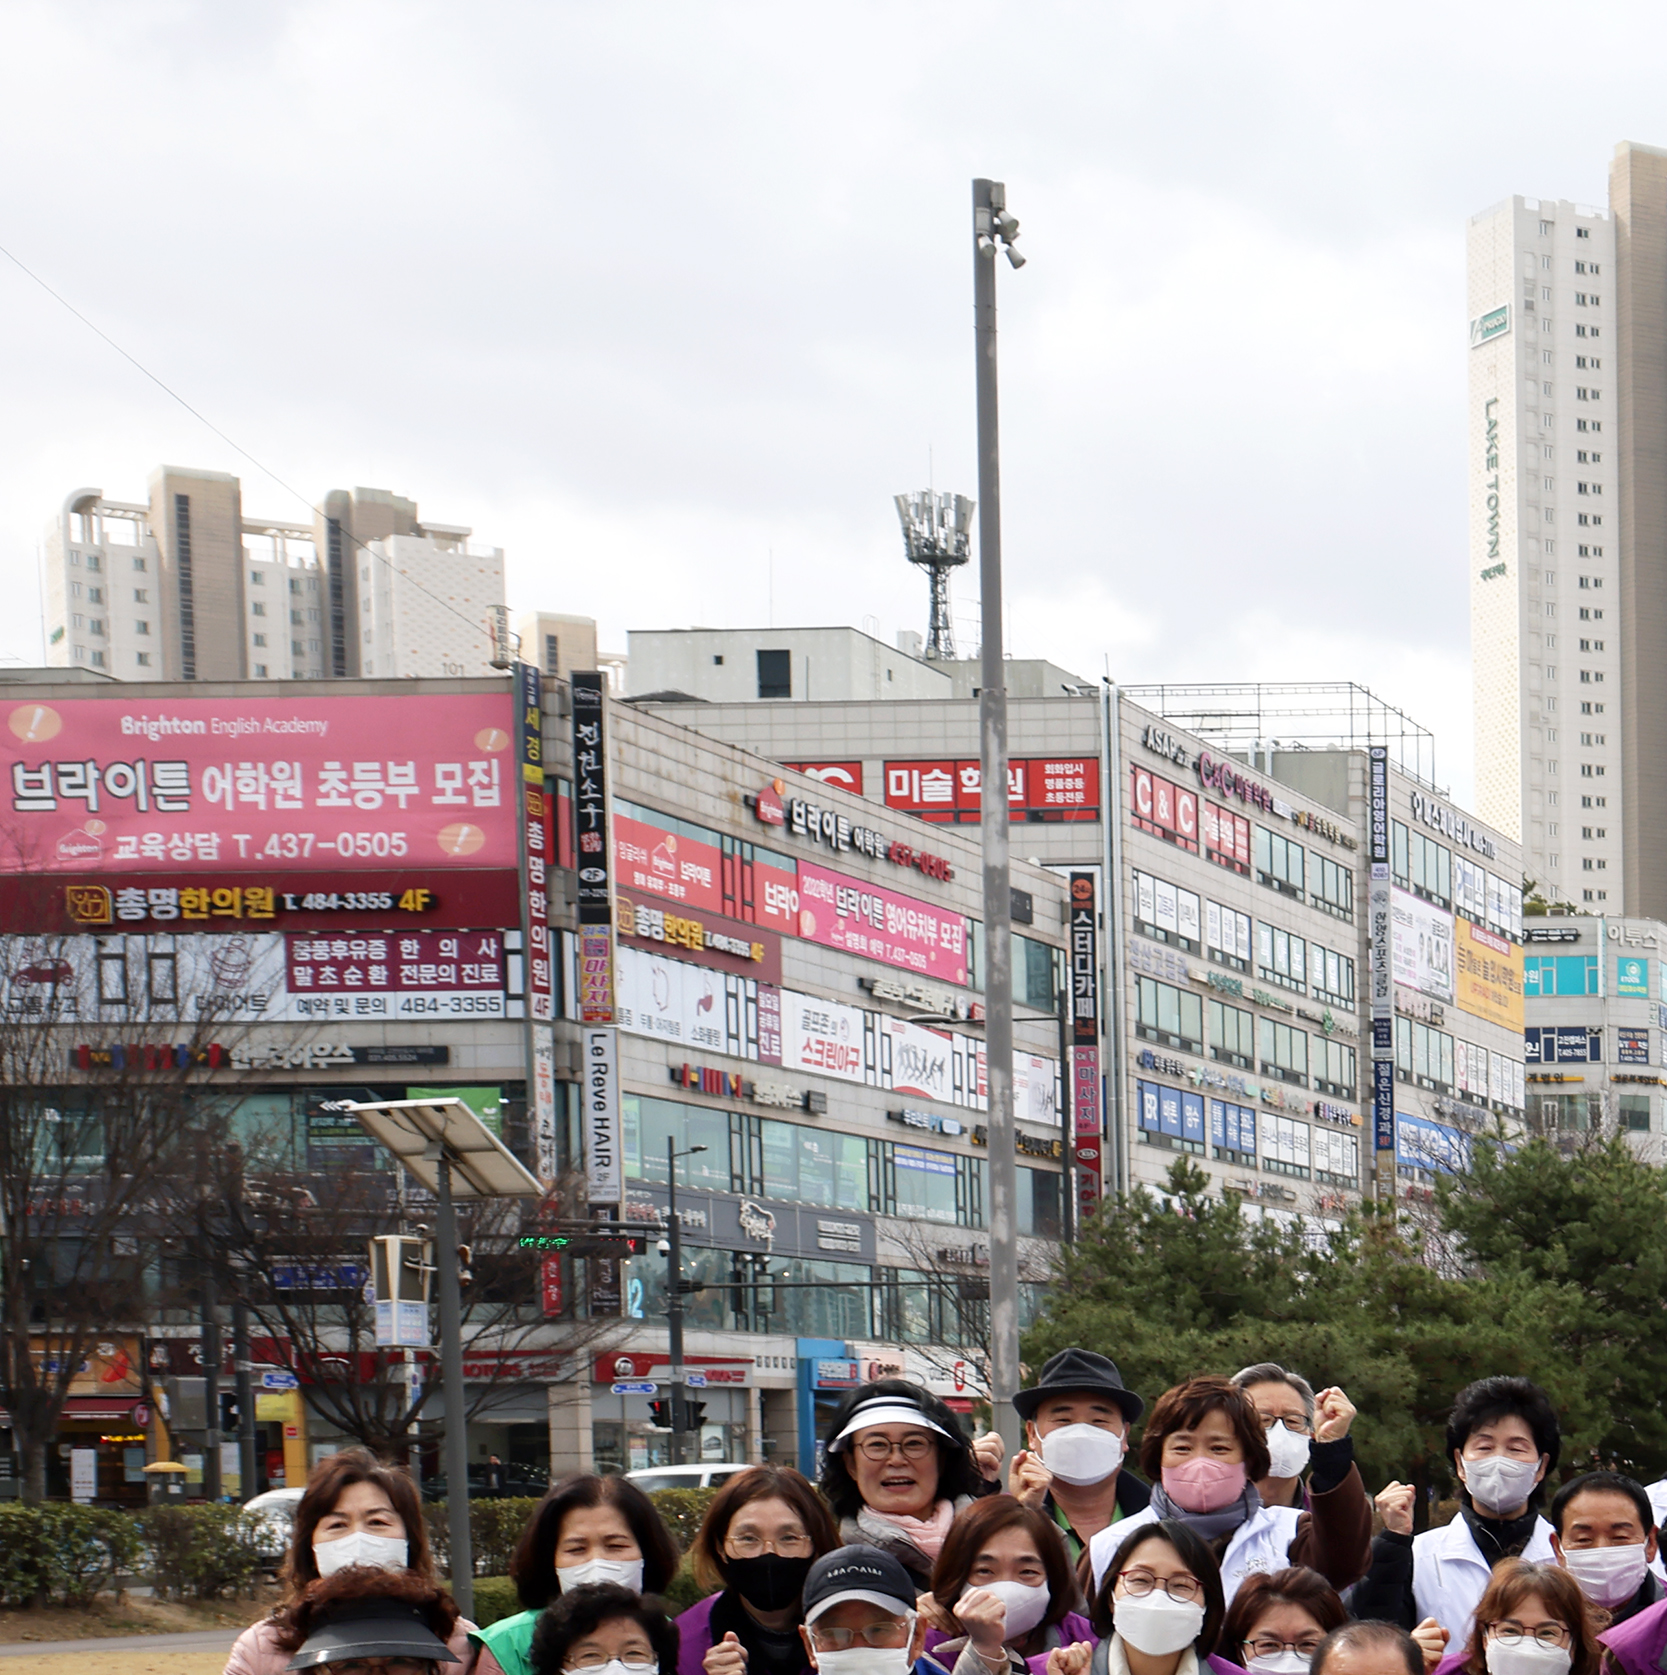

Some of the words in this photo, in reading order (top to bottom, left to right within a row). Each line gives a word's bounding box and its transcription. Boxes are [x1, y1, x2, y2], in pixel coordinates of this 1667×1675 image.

[1485, 396, 1499, 472] LAKE
[1486, 474, 1500, 558] TOWN
[121, 715, 206, 742] Brighton
[211, 717, 261, 738] English
[263, 717, 328, 737] Academy
[12, 758, 191, 813] 브라이튼
[202, 761, 304, 811] 어학원
[316, 760, 420, 810] 초등부
[431, 758, 502, 807] 모집
[113, 832, 221, 861] 교육상담
[791, 797, 850, 852] 브라이튼
[853, 826, 885, 859] 어학원
[888, 840, 951, 882] 437-0505
[680, 861, 712, 888] 브라이튼
[115, 886, 277, 920] 총명한의원
[301, 892, 392, 911] 484-3355
[398, 888, 431, 912] 4F
[527, 821, 549, 988] 총명한의원
[835, 884, 884, 931] 브라이튼
[940, 921, 963, 955] 모집
[634, 904, 704, 952] 총명한의원
[1607, 925, 1658, 949] 이투스
[400, 964, 457, 985] 전문의
[461, 963, 501, 984] 진료
[584, 959, 609, 1004] 마사지
[1073, 910, 1097, 1019] 스터디카페
[297, 996, 331, 1015] 예약
[335, 997, 350, 1014] 및
[354, 996, 387, 1015] 문의
[401, 996, 502, 1014] 484-3355
[533, 997, 549, 1016] 4F
[590, 1033, 608, 1058] Le
[758, 1031, 782, 1058] 진료
[801, 1037, 861, 1075] 스크린야구
[591, 1062, 609, 1112] Reve
[1079, 1066, 1098, 1124] 마사지
[593, 1117, 612, 1168] HAIR
